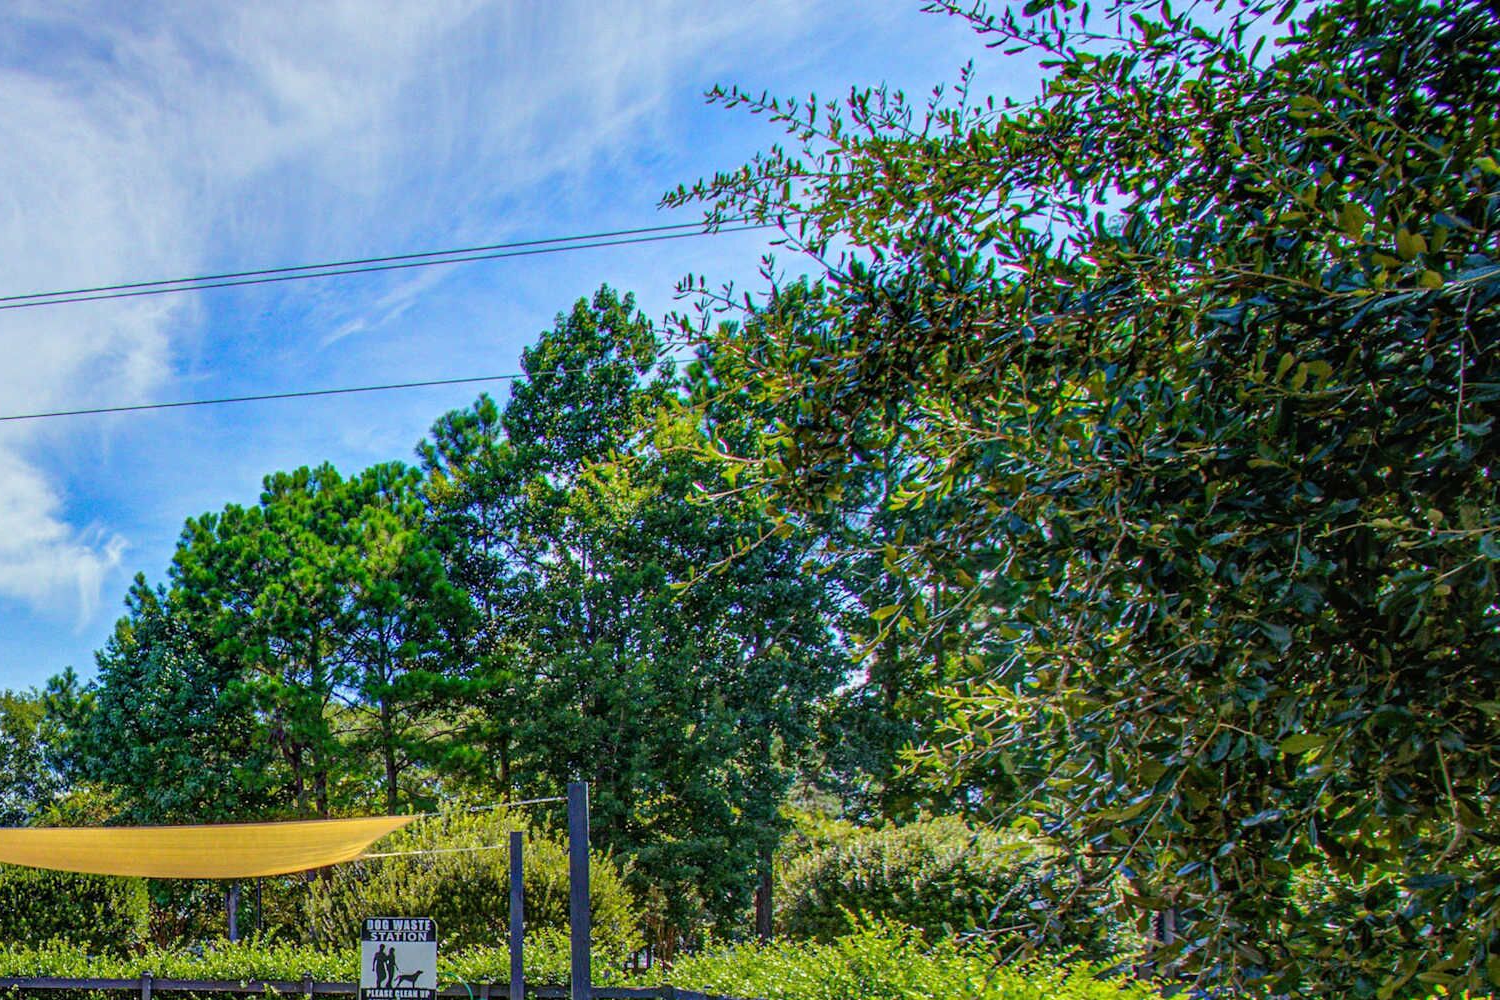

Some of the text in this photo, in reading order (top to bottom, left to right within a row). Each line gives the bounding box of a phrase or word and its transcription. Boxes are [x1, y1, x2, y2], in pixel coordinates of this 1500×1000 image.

[367, 920, 431, 930] DOG WASTE
[371, 932, 427, 941] STATION
[367, 990, 430, 998] PLEASE CLEAN UP
